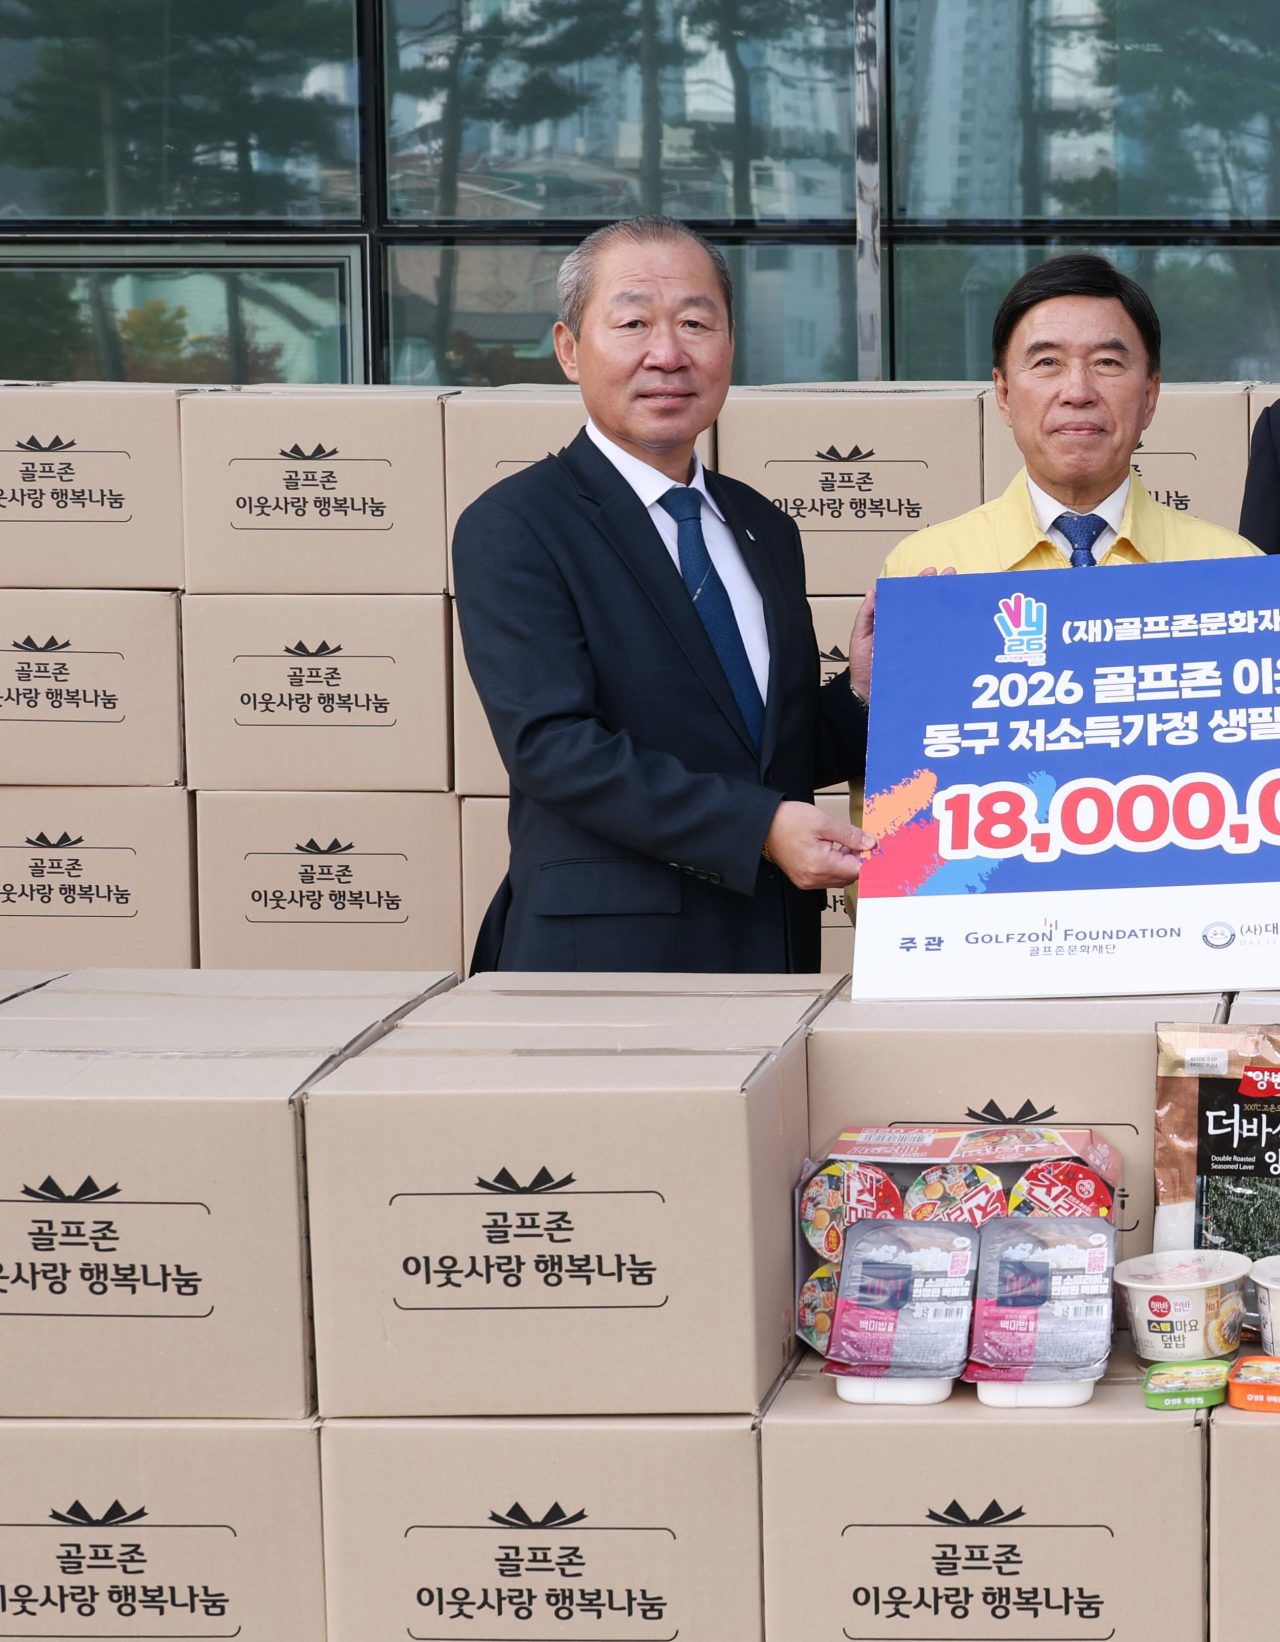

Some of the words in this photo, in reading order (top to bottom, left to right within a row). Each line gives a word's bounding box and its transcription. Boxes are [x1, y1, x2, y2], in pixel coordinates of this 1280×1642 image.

[19, 462, 76, 483] 골프존
[282, 470, 338, 491] 골프존
[818, 471, 874, 493] 골프존
[50, 488, 126, 509] 행복나눔
[235, 496, 309, 517] 이웃사랑
[312, 496, 387, 518] 행복나눔
[772, 497, 845, 519] 이웃사랑
[848, 497, 923, 519] 행복나눔
[1007, 638, 1044, 653] 26
[14, 661, 70, 683] 골프존
[286, 666, 342, 687] 골프존
[971, 669, 1084, 709] 2026
[1093, 659, 1223, 702] 골프존
[0, 687, 41, 709] 사랑
[45, 688, 119, 710] 행복나눔
[240, 692, 313, 714] 이웃사랑
[317, 692, 391, 714] 행복나눔
[922, 721, 1000, 758] 동구
[1008, 711, 1199, 752] 저소득가정
[28, 857, 84, 878] 골프존
[298, 864, 354, 885] 골프존
[58, 883, 132, 905] 행복나눔
[250, 889, 325, 911] 이웃사랑
[328, 889, 403, 911] 행복나눔
[964, 929, 1053, 945] GOLFZON
[1063, 927, 1181, 942] FOUNDATION
[1029, 943, 1116, 957] 골프존문화재단
[1211, 1162, 1239, 1170] Seasoned
[1232, 1155, 1256, 1163] Roasted
[27, 1219, 120, 1253] 골프존
[481, 1211, 575, 1245] 골프존
[78, 1262, 203, 1297] 행복나눔
[402, 1254, 527, 1288] 이웃사랑
[533, 1253, 657, 1288] 행복나눔
[1150, 1302, 1169, 1314] 햇반
[1161, 1334, 1187, 1349] 덮밥
[55, 1543, 148, 1575] 골프존
[494, 1545, 586, 1578] 골프존
[931, 1543, 1024, 1577] 골프존
[106, 1584, 230, 1618] 행복나눔
[416, 1587, 538, 1621] 이웃사랑
[544, 1587, 668, 1621] 행복나눔
[852, 1586, 974, 1620] 이웃사랑
[981, 1586, 1105, 1620] 행복나눔
